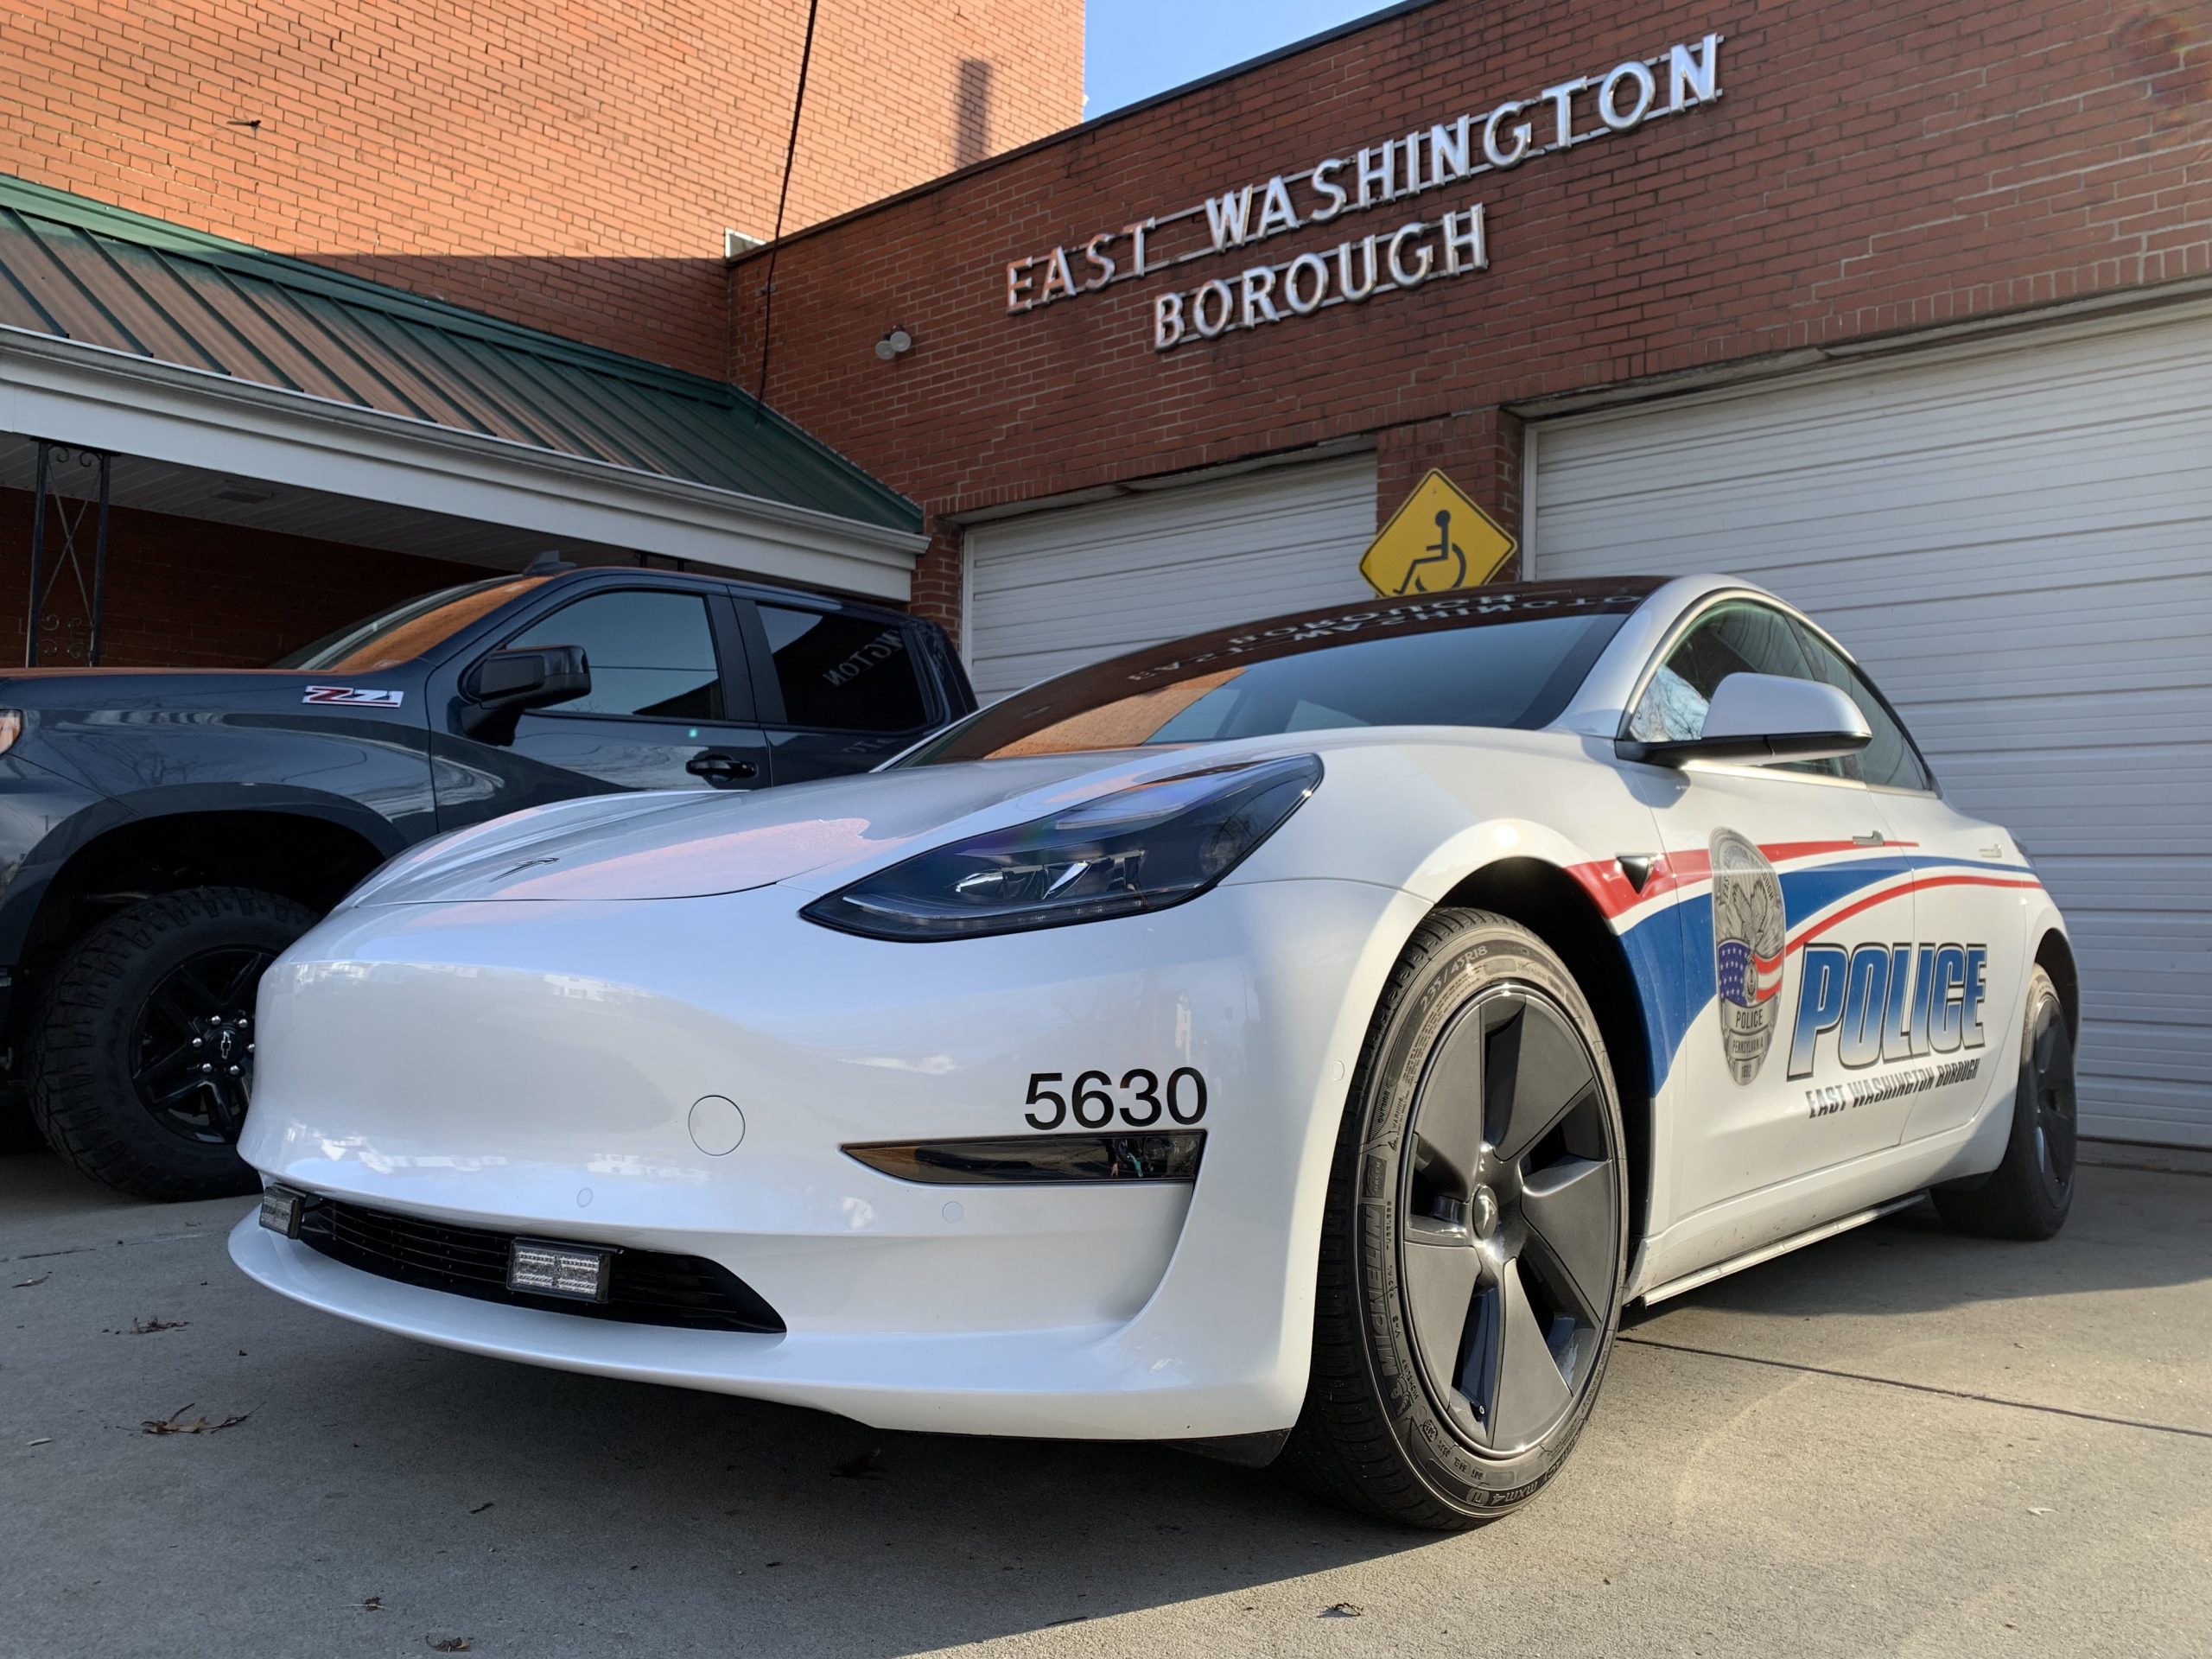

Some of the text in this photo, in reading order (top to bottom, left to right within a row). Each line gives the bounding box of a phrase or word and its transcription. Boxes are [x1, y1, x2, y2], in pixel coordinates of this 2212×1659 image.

[1006, 33, 1724, 316] EAST WASHINGTON
[1154, 201, 1489, 353] BOROUGH
[302, 685, 404, 709] Z71
[1735, 1008, 1764, 1029] POLICE
[1787, 943, 1987, 1082] POLICE
[1024, 1066, 1208, 1131] 5630
[1805, 1058, 1981, 1119] EAST WASHINGTON BOROUGH
[1364, 1205, 1399, 1376] MICHELIN
